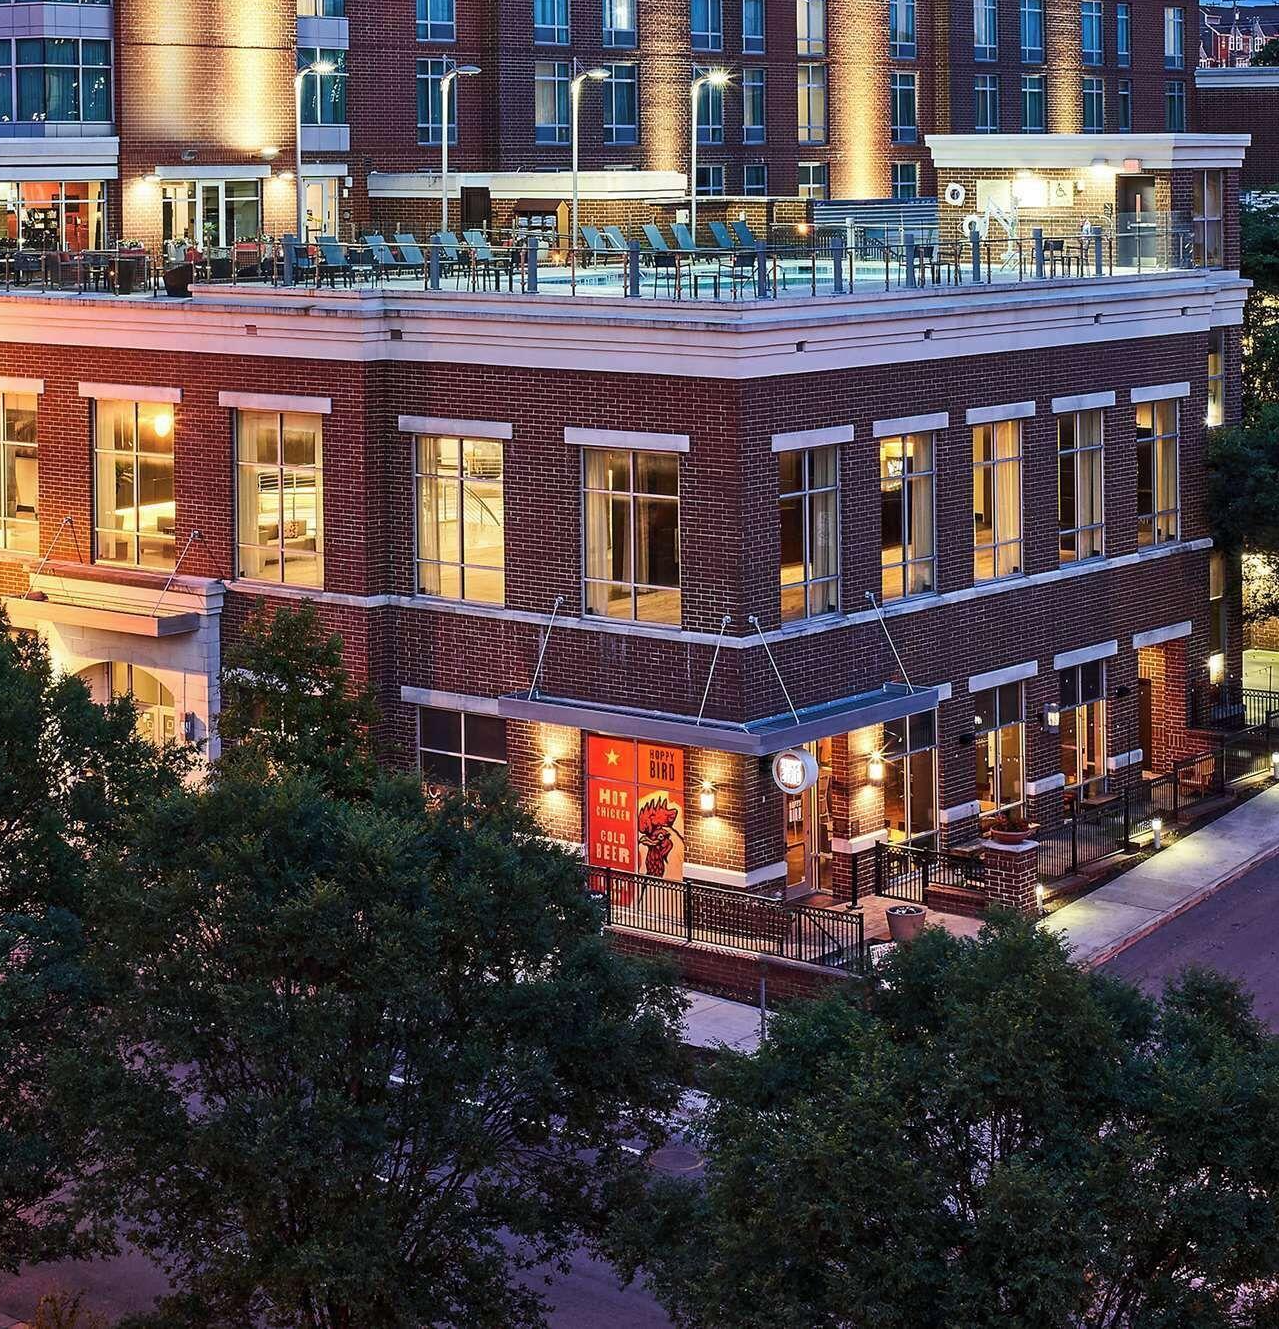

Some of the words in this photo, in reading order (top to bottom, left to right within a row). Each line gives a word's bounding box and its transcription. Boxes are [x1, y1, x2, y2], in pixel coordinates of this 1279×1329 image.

[649, 749, 675, 762] HOPPY
[649, 760, 675, 782] BIRD
[599, 788, 628, 808] HOT
[596, 806, 631, 822] CHICKEN
[600, 829, 626, 845] COLD
[596, 843, 630, 864] BEER
